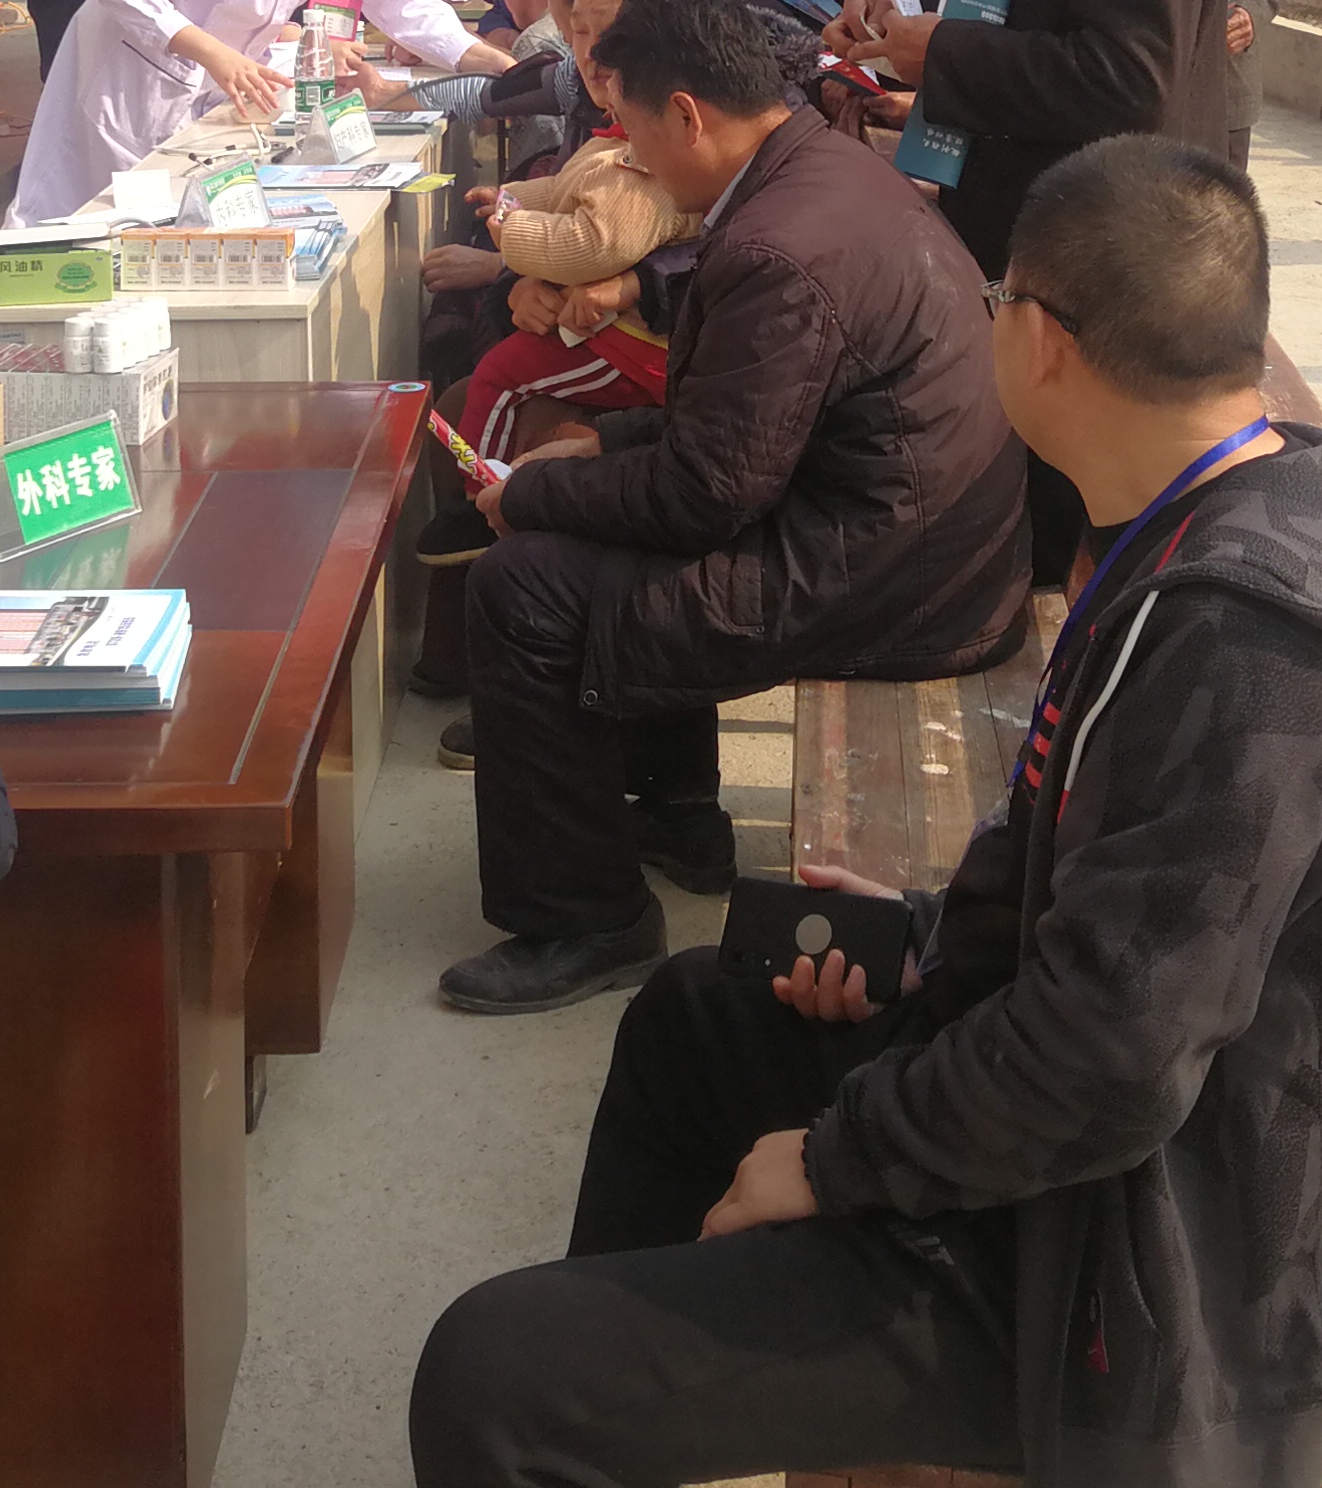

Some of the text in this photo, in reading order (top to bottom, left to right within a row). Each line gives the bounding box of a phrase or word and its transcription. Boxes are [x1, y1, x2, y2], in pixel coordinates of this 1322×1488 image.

[0, 259, 44, 273] 风油精
[16, 444, 122, 517] 外科专家
